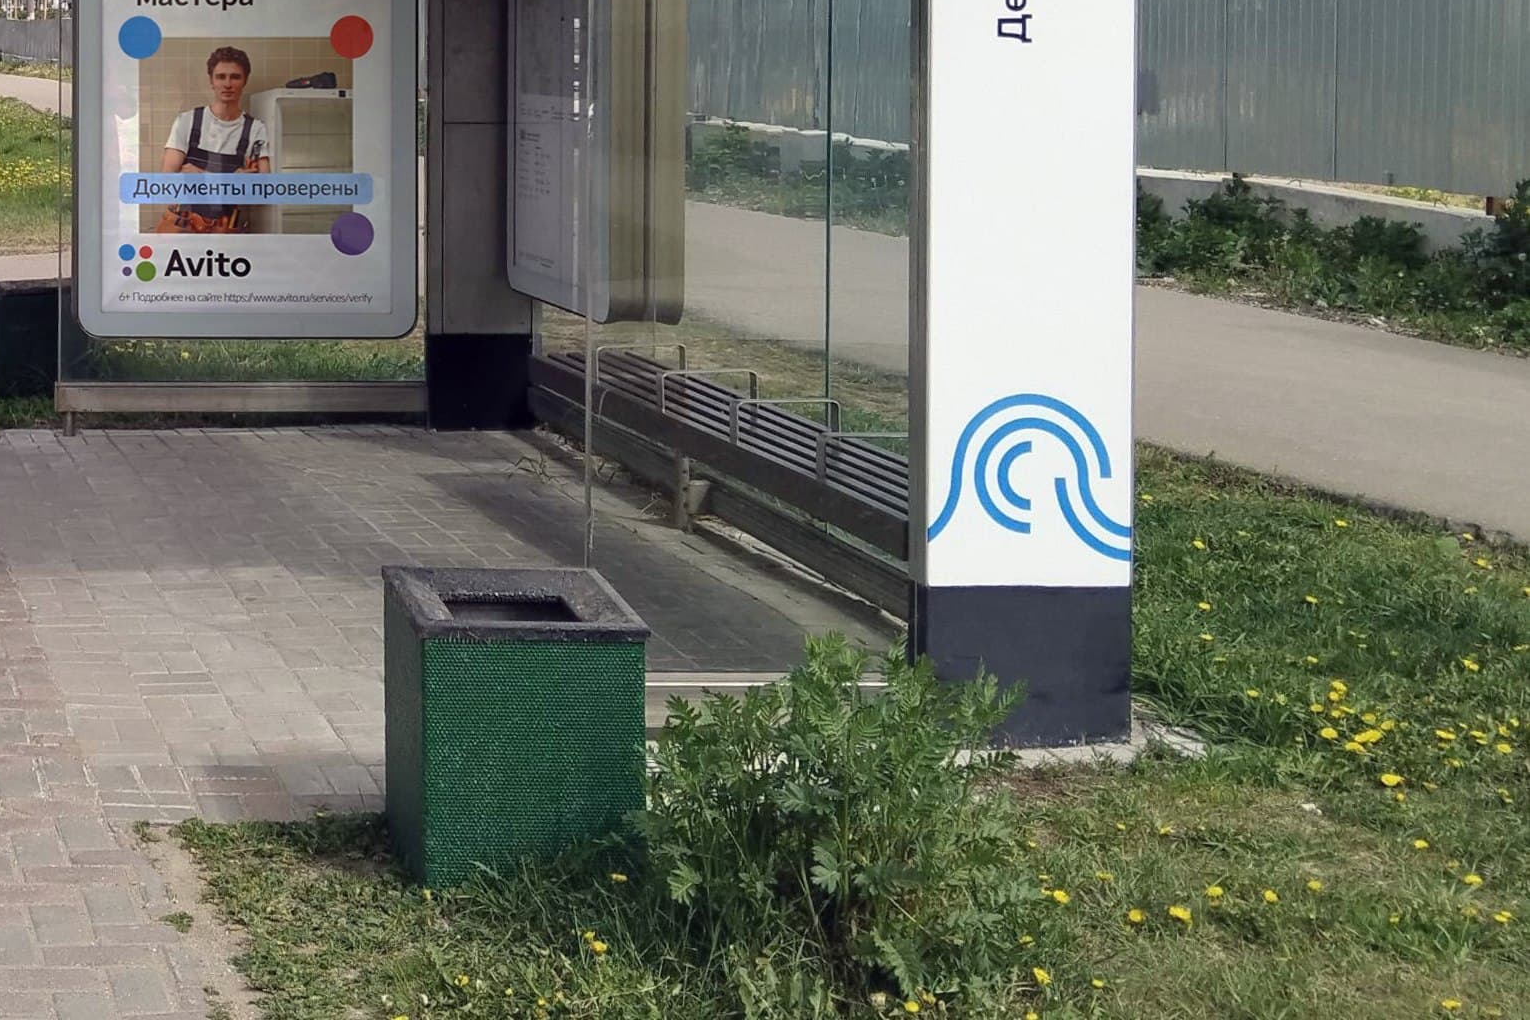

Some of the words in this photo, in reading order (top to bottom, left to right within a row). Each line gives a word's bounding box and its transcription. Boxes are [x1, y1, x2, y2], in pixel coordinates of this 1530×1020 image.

[132, 178, 246, 199] Документы
[252, 181, 359, 199] проверены
[164, 248, 252, 278] Avito
[132, 292, 184, 303] Подробнее
[185, 294, 196, 302] на
[197, 292, 222, 302] сайте
